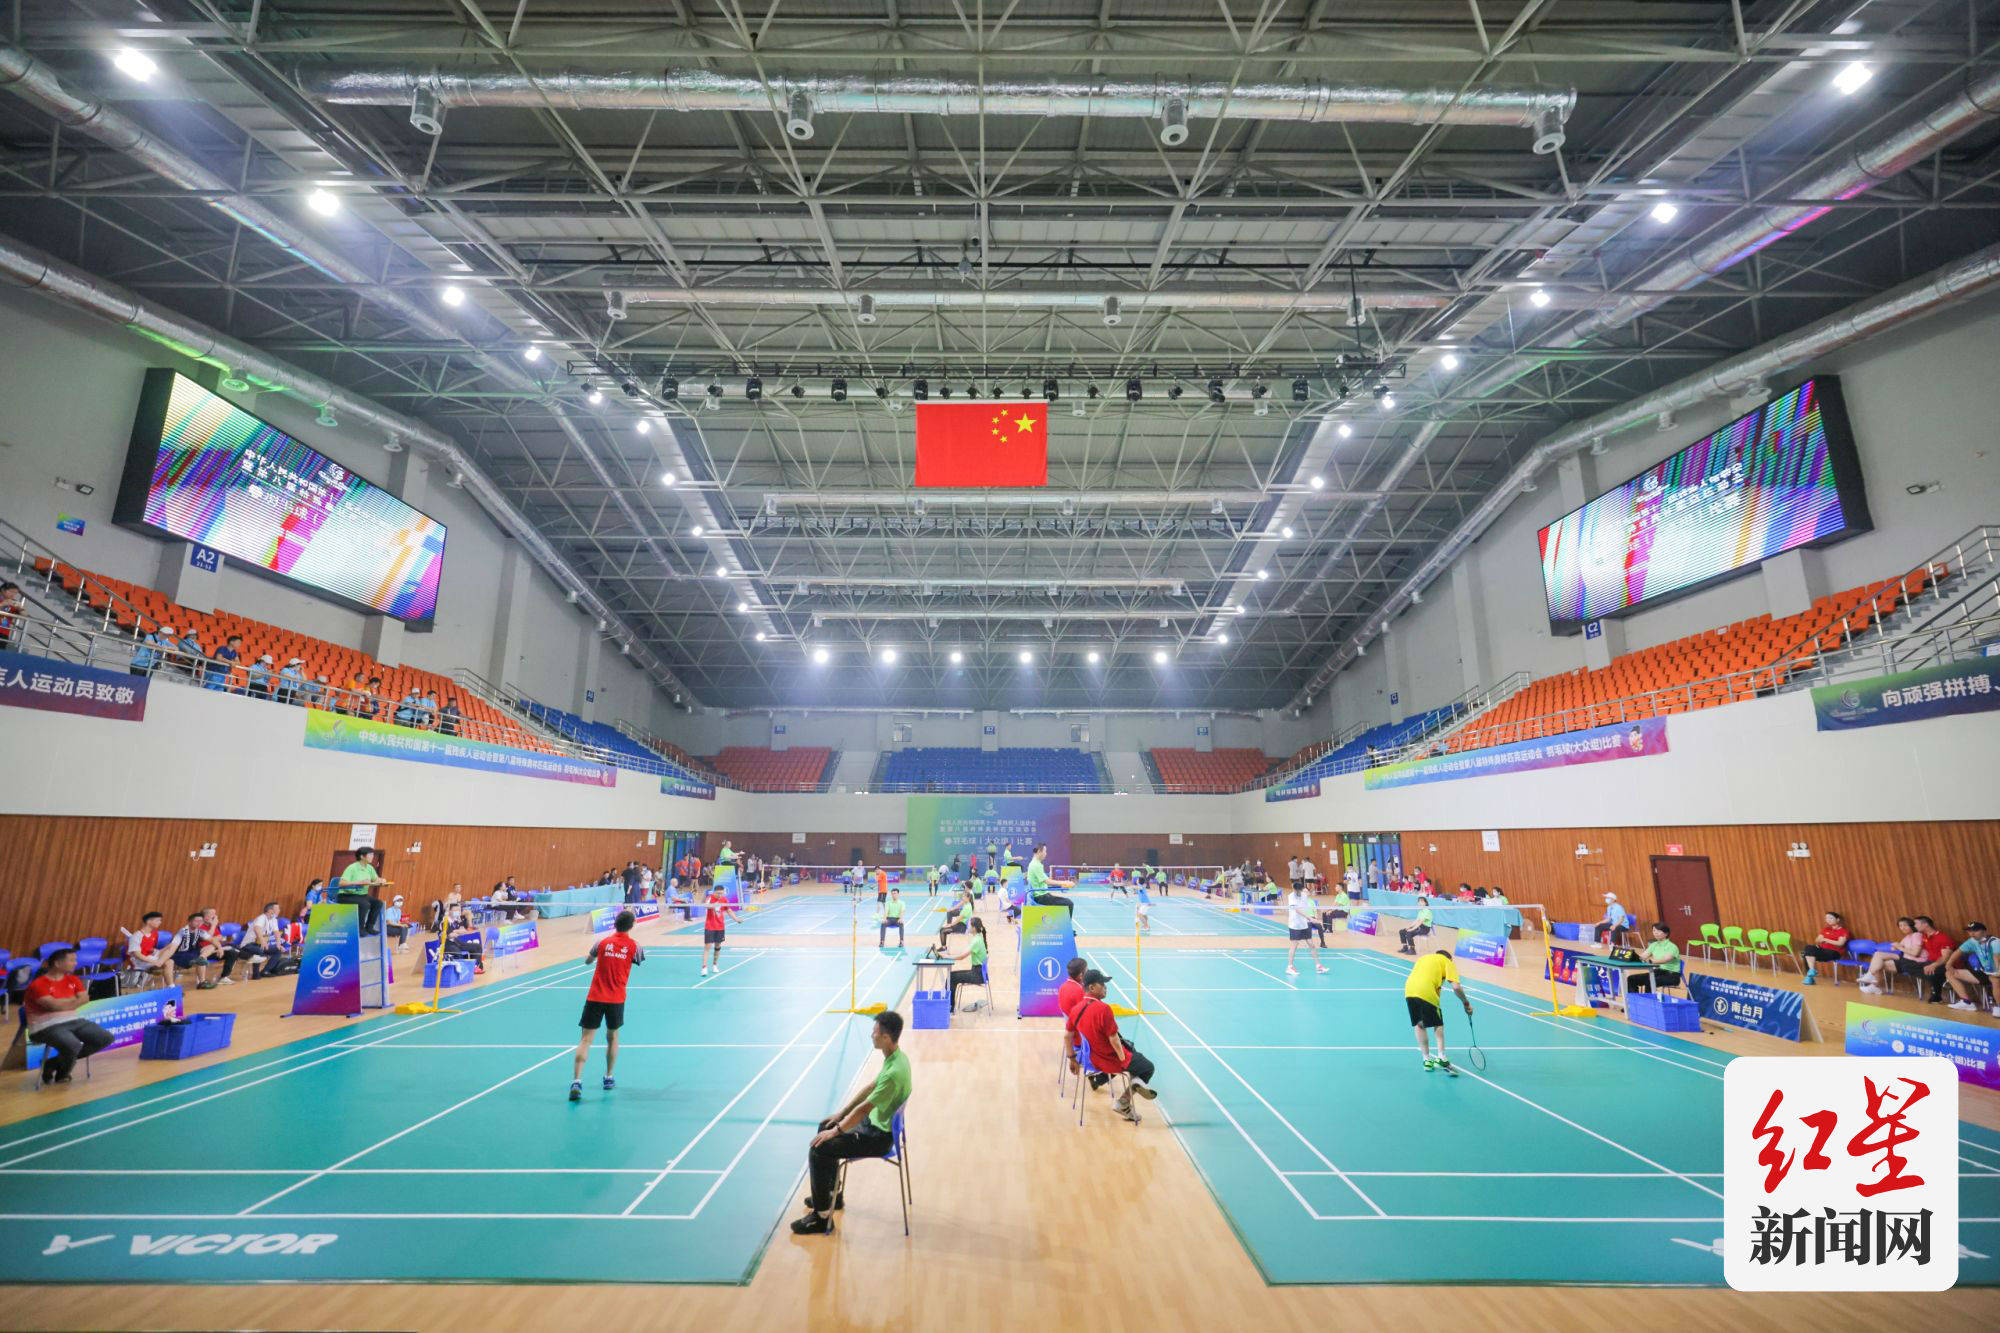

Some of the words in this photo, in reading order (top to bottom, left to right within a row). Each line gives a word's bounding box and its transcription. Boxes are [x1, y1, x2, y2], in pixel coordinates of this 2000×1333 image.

[196, 548, 215, 564] A2
[1588, 622, 1598, 633] C2
[1624, 950, 1632, 959] 2
[1731, 1001, 1763, 1019] 南台月
[130, 1234, 338, 1255] VICTOR
